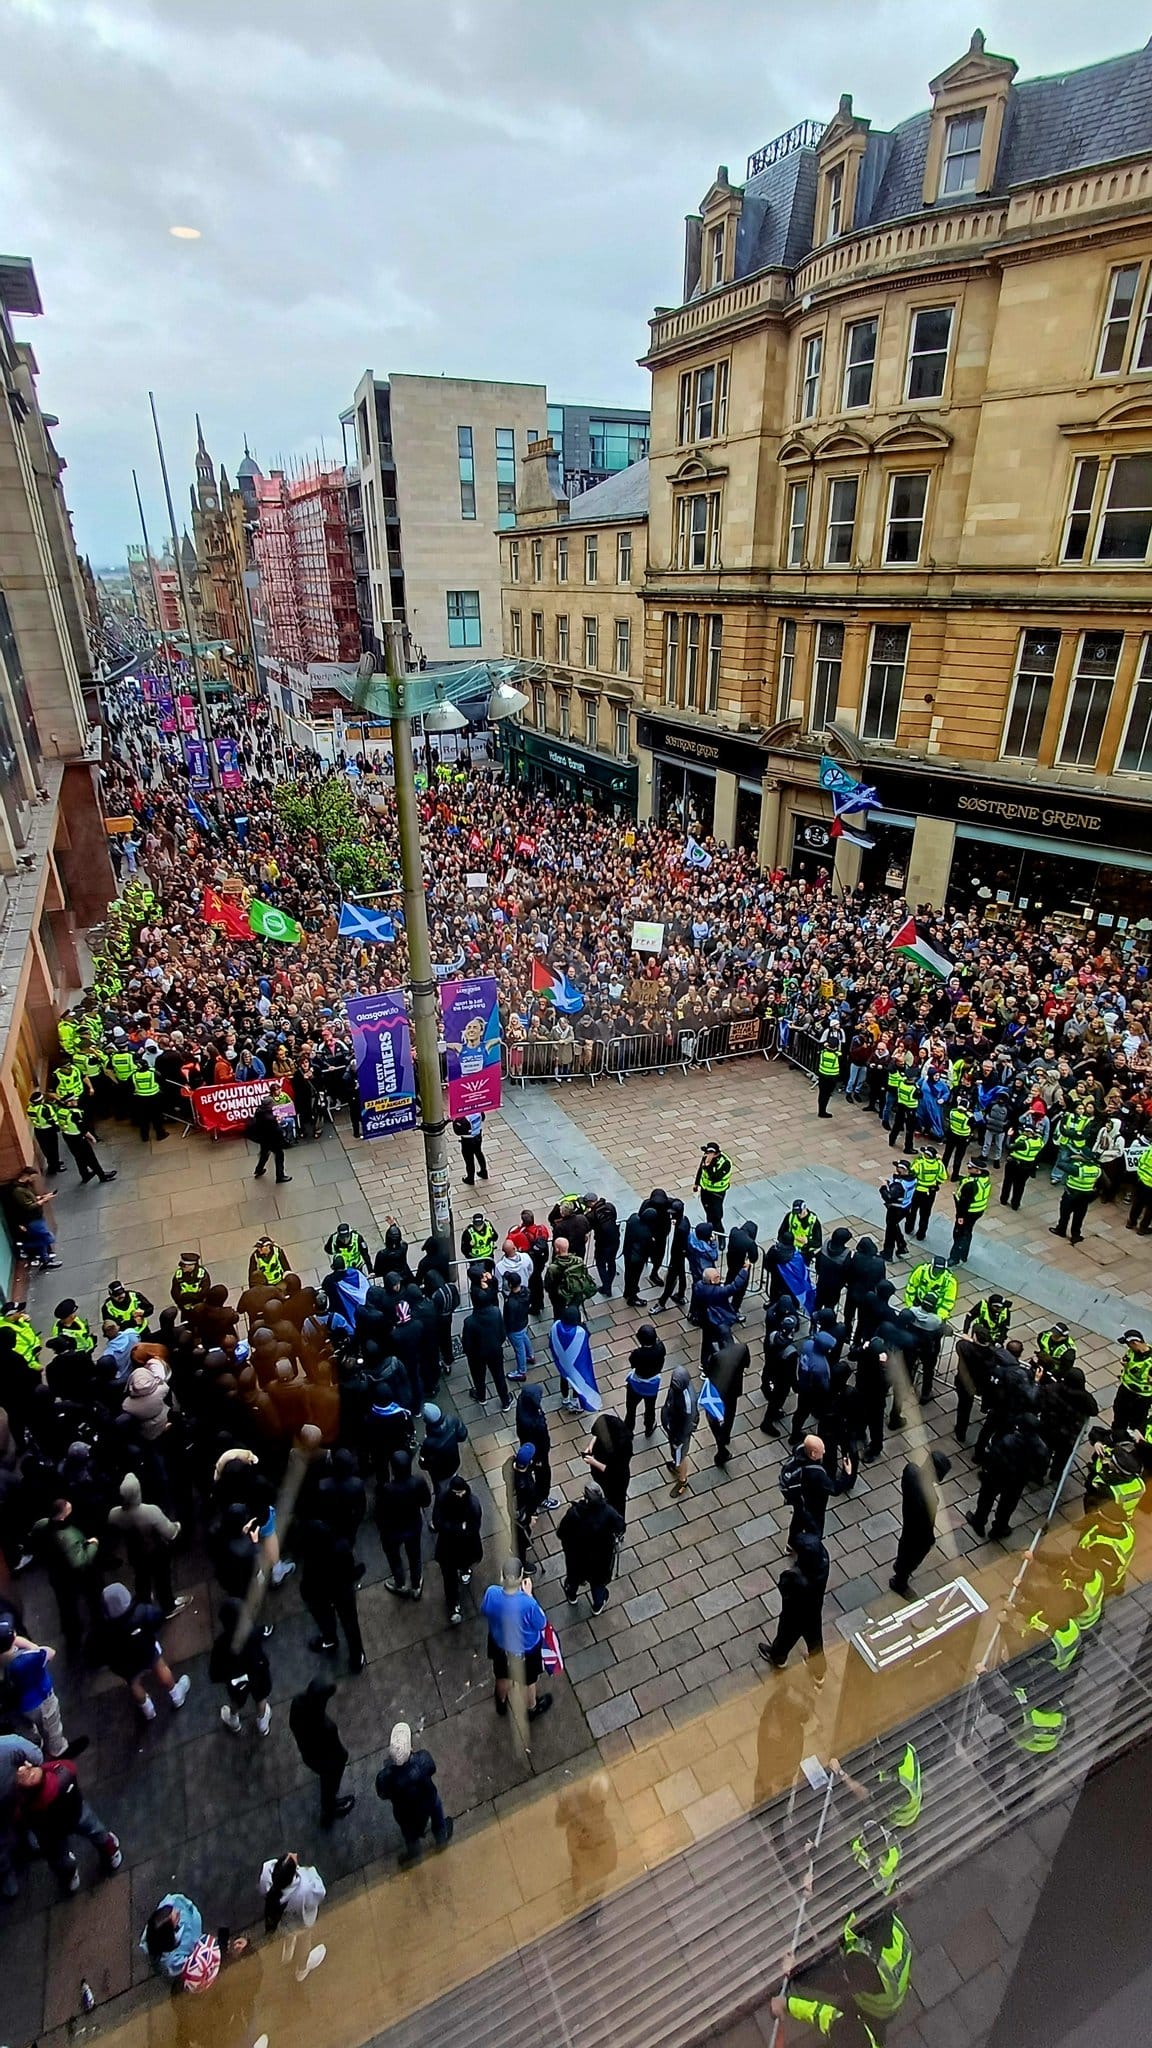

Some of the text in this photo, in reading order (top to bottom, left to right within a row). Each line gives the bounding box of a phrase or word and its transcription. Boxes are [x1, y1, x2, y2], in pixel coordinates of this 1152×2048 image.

[957, 796, 1102, 830] SØSTRENE GRENE
[379, 1031, 397, 1093] GATHERS
[226, 1107, 258, 1121] GROU
[366, 1111, 413, 1131] festival
